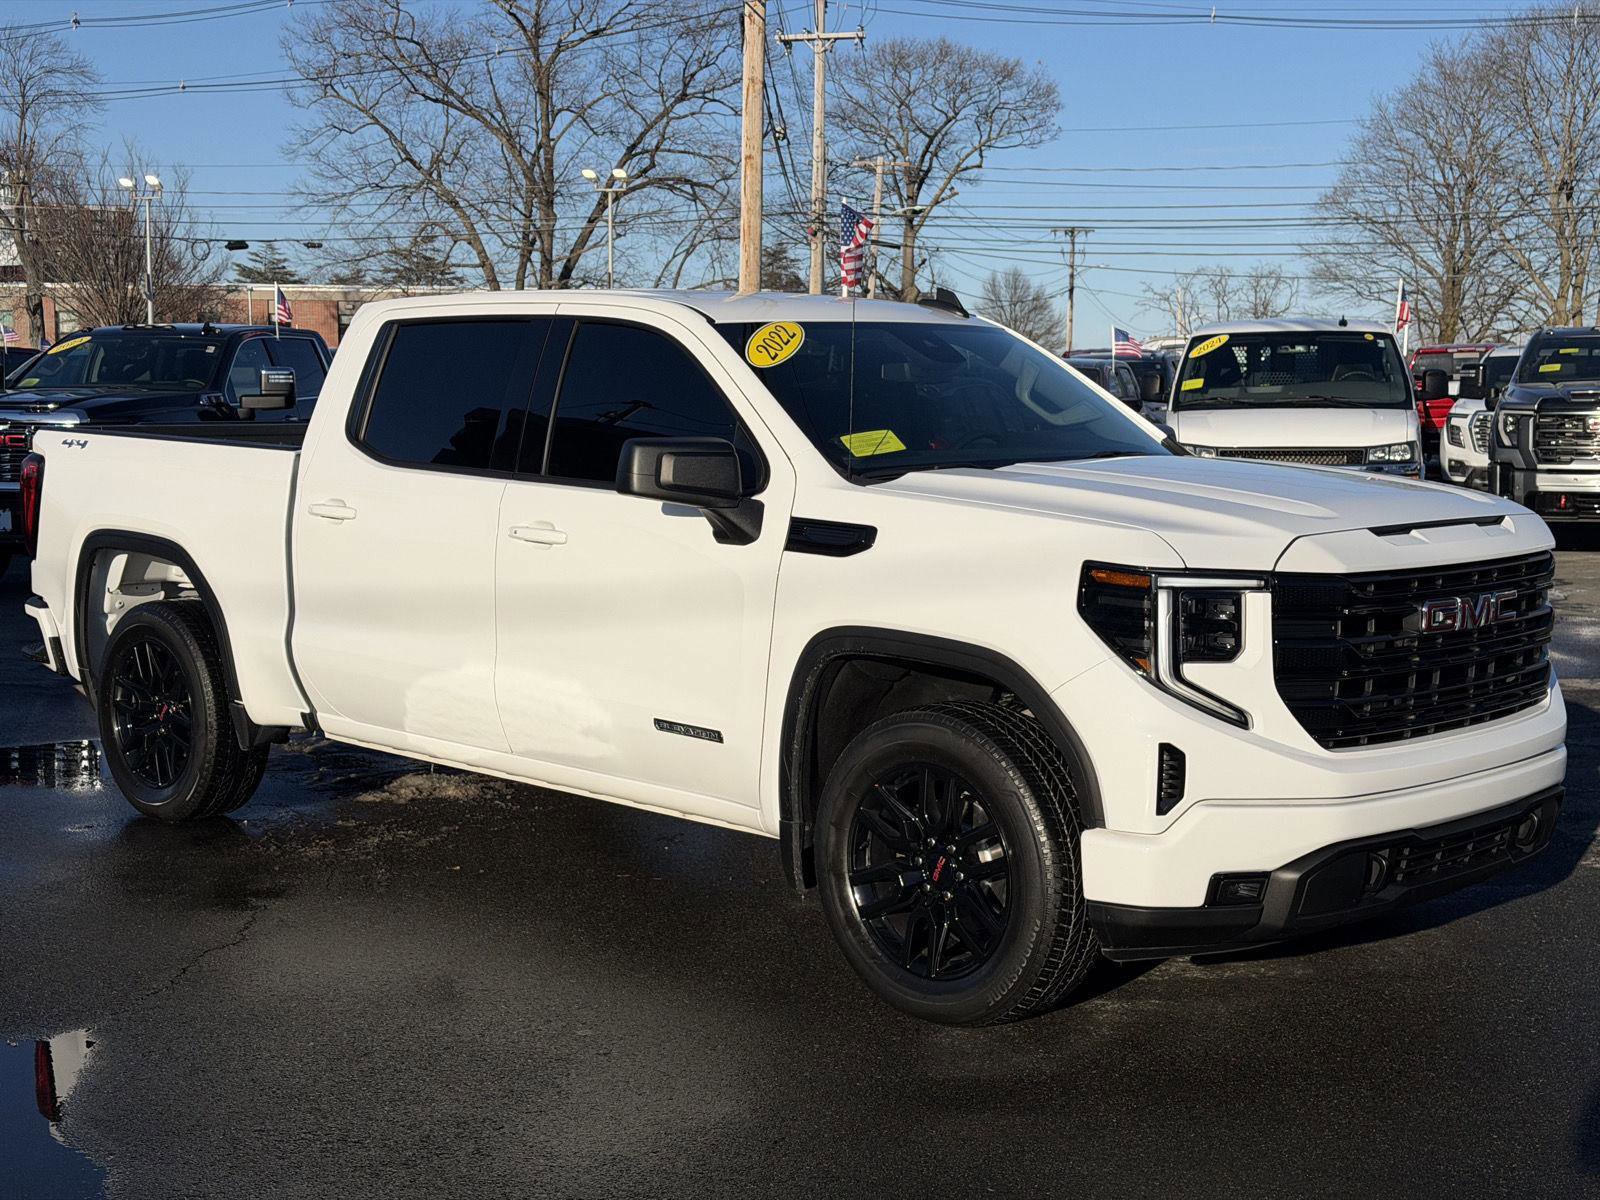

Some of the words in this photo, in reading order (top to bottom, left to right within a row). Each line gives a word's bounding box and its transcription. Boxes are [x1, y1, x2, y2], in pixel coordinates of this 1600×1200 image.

[755, 324, 797, 361] 2022
[1421, 590, 1518, 634] GMC
[932, 856, 946, 881] GMC
